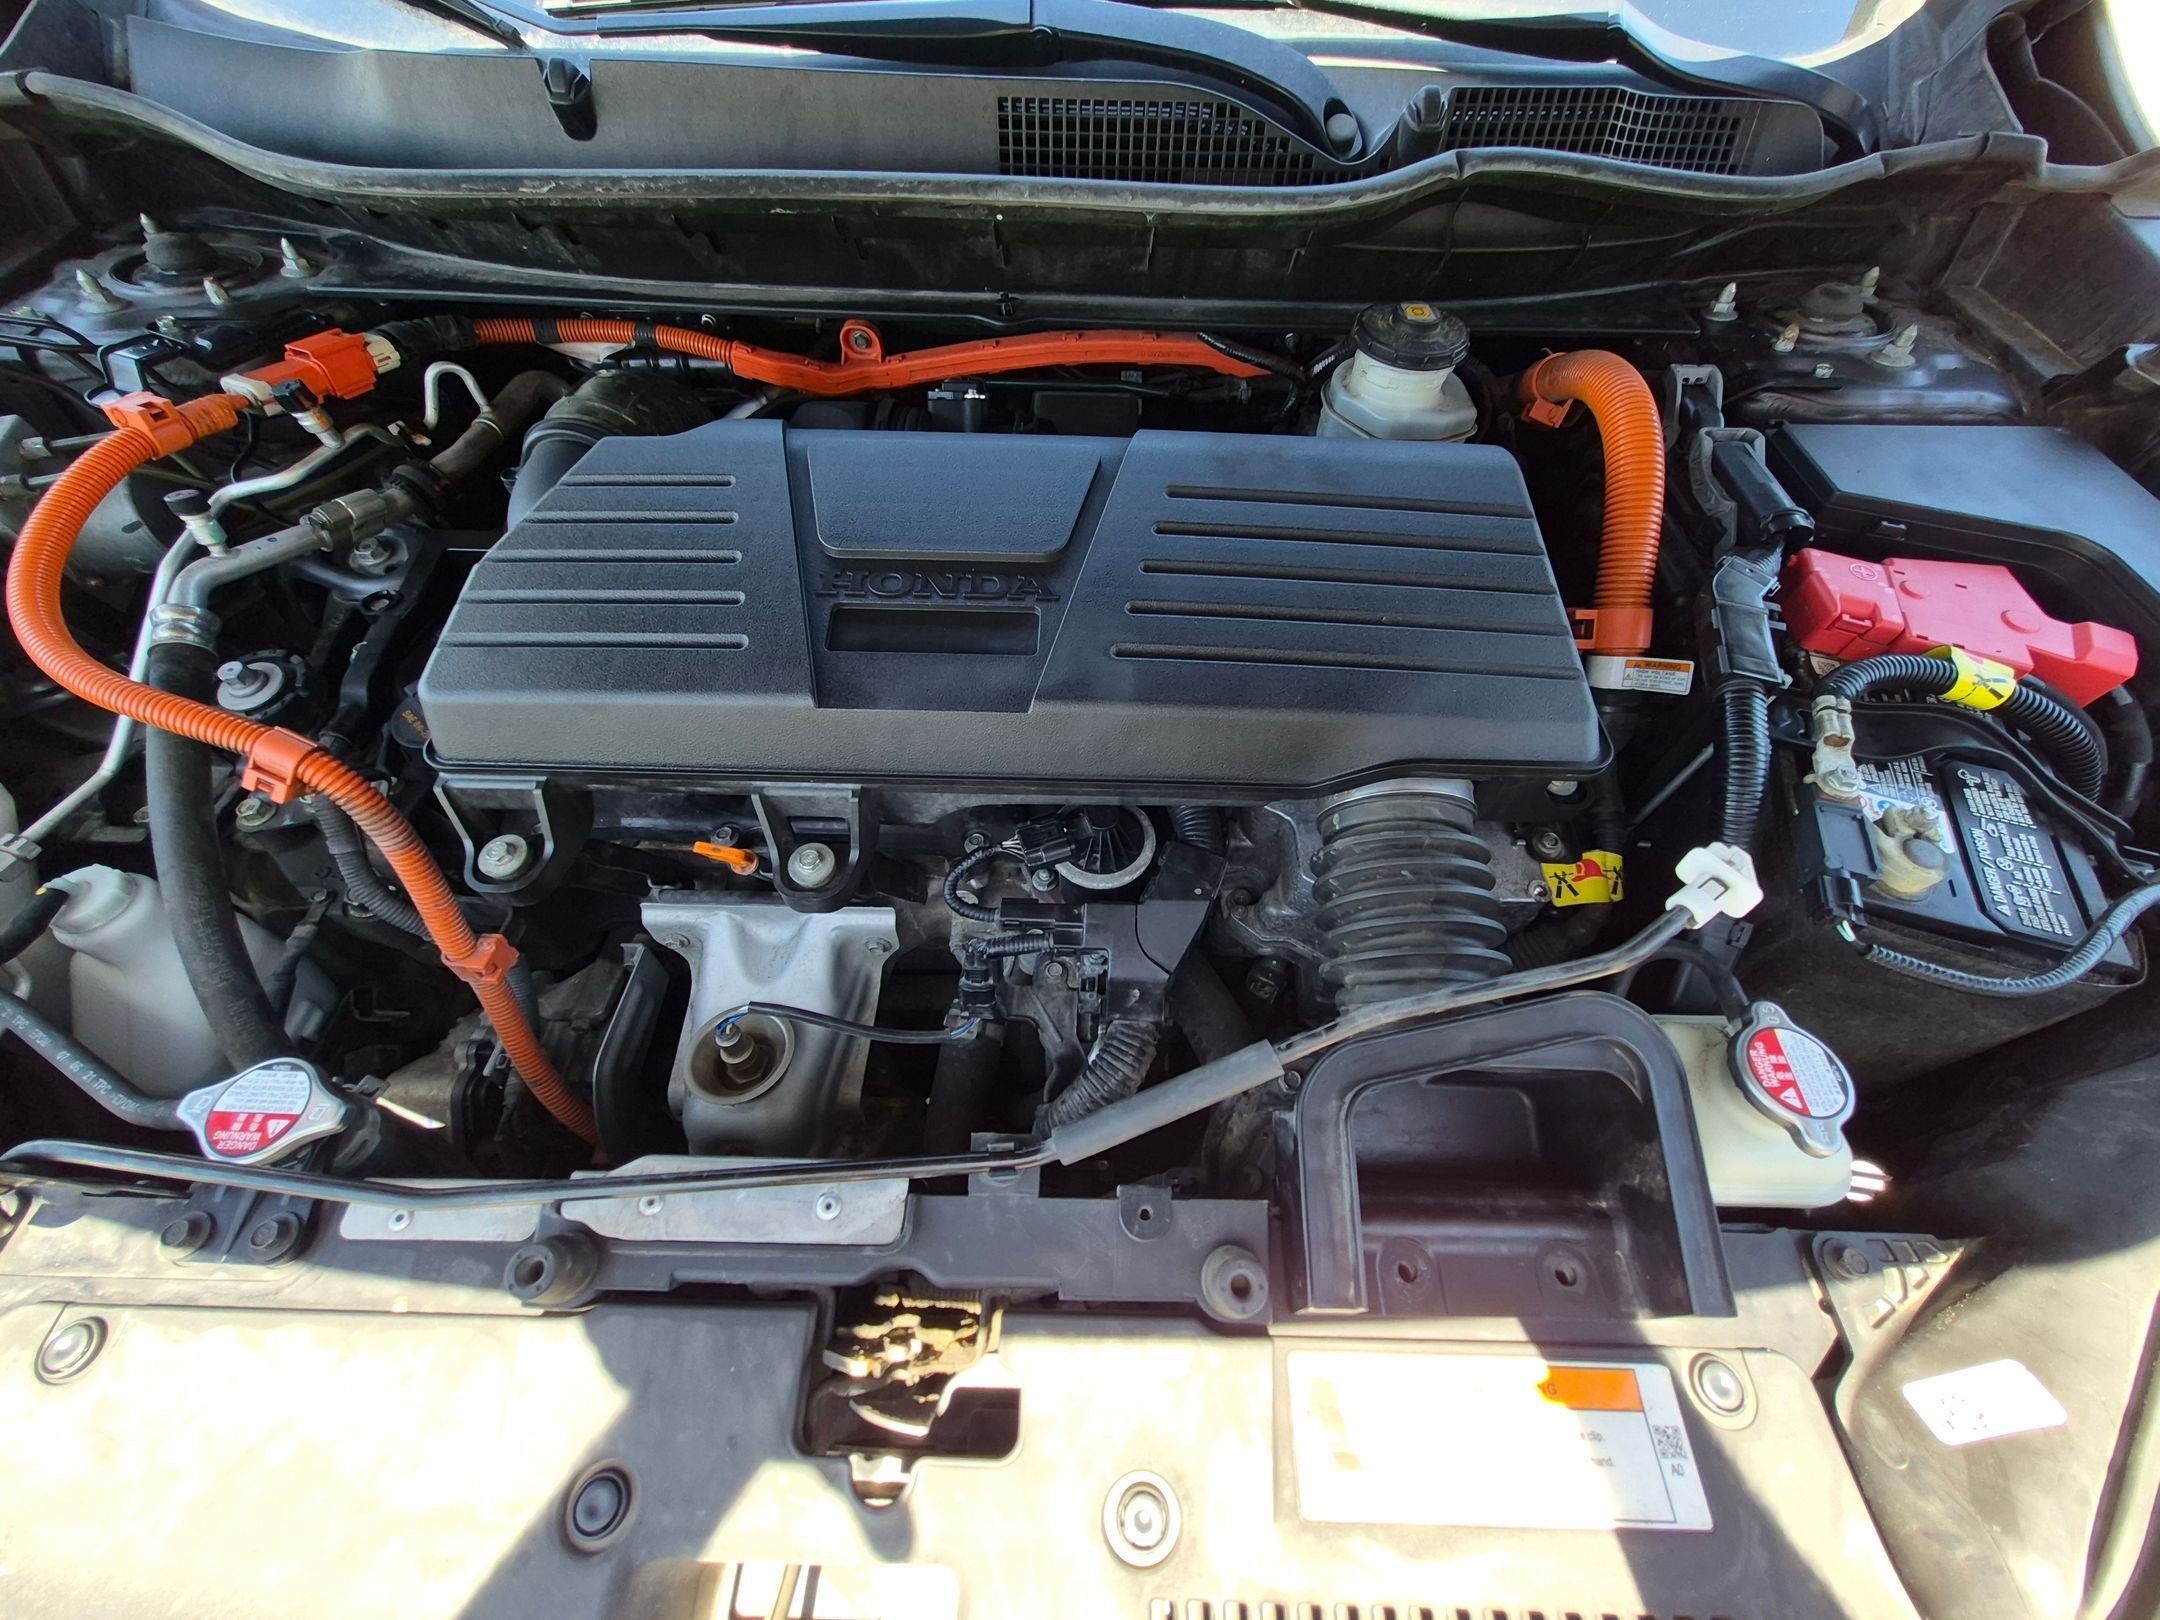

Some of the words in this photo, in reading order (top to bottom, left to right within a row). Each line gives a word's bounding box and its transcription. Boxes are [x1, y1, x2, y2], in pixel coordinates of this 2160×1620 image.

[815, 570, 1061, 600] HONDA
[1748, 1048, 1773, 1087] DANGER
[1753, 1040, 1781, 1087] WARNUNG
[212, 1130, 263, 1142] WARNUNG
[216, 1140, 258, 1151] DANGER
